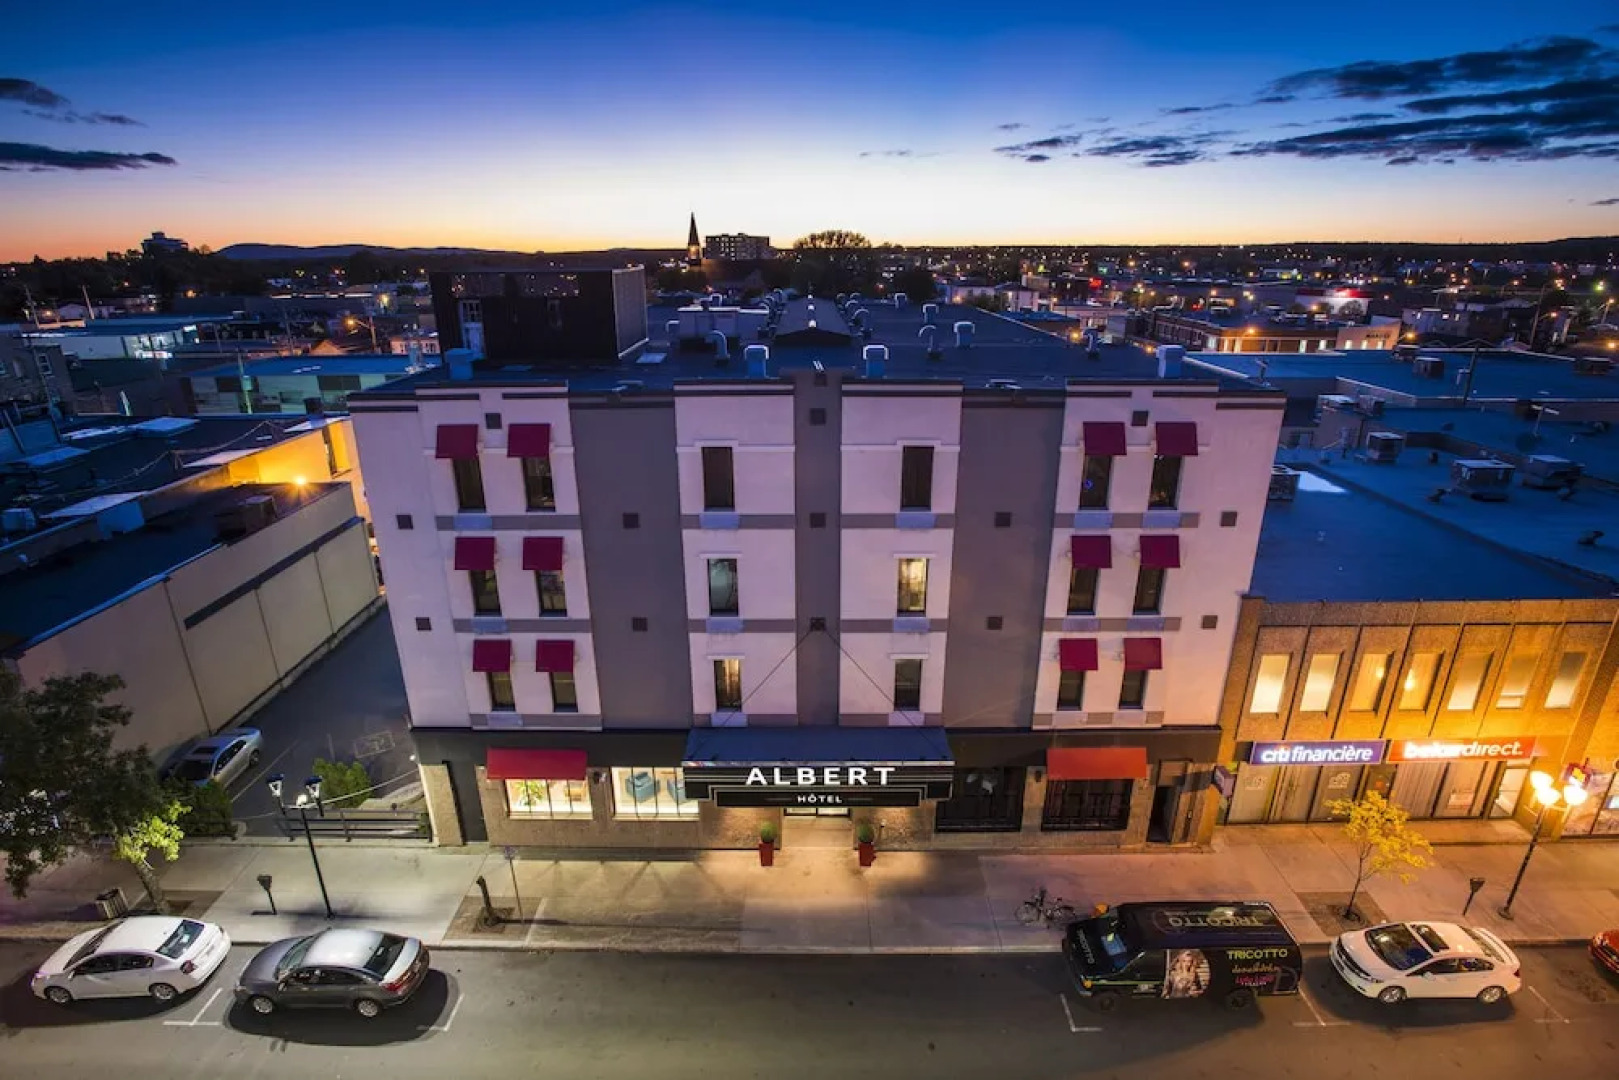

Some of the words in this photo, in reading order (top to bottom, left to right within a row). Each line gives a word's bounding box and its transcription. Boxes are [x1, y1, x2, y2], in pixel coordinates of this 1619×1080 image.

[1291, 745, 1373, 762] financière
[745, 767, 896, 786] ALBERT
[797, 793, 843, 804] HÔTEL
[1227, 948, 1288, 960] TRICOTTO
